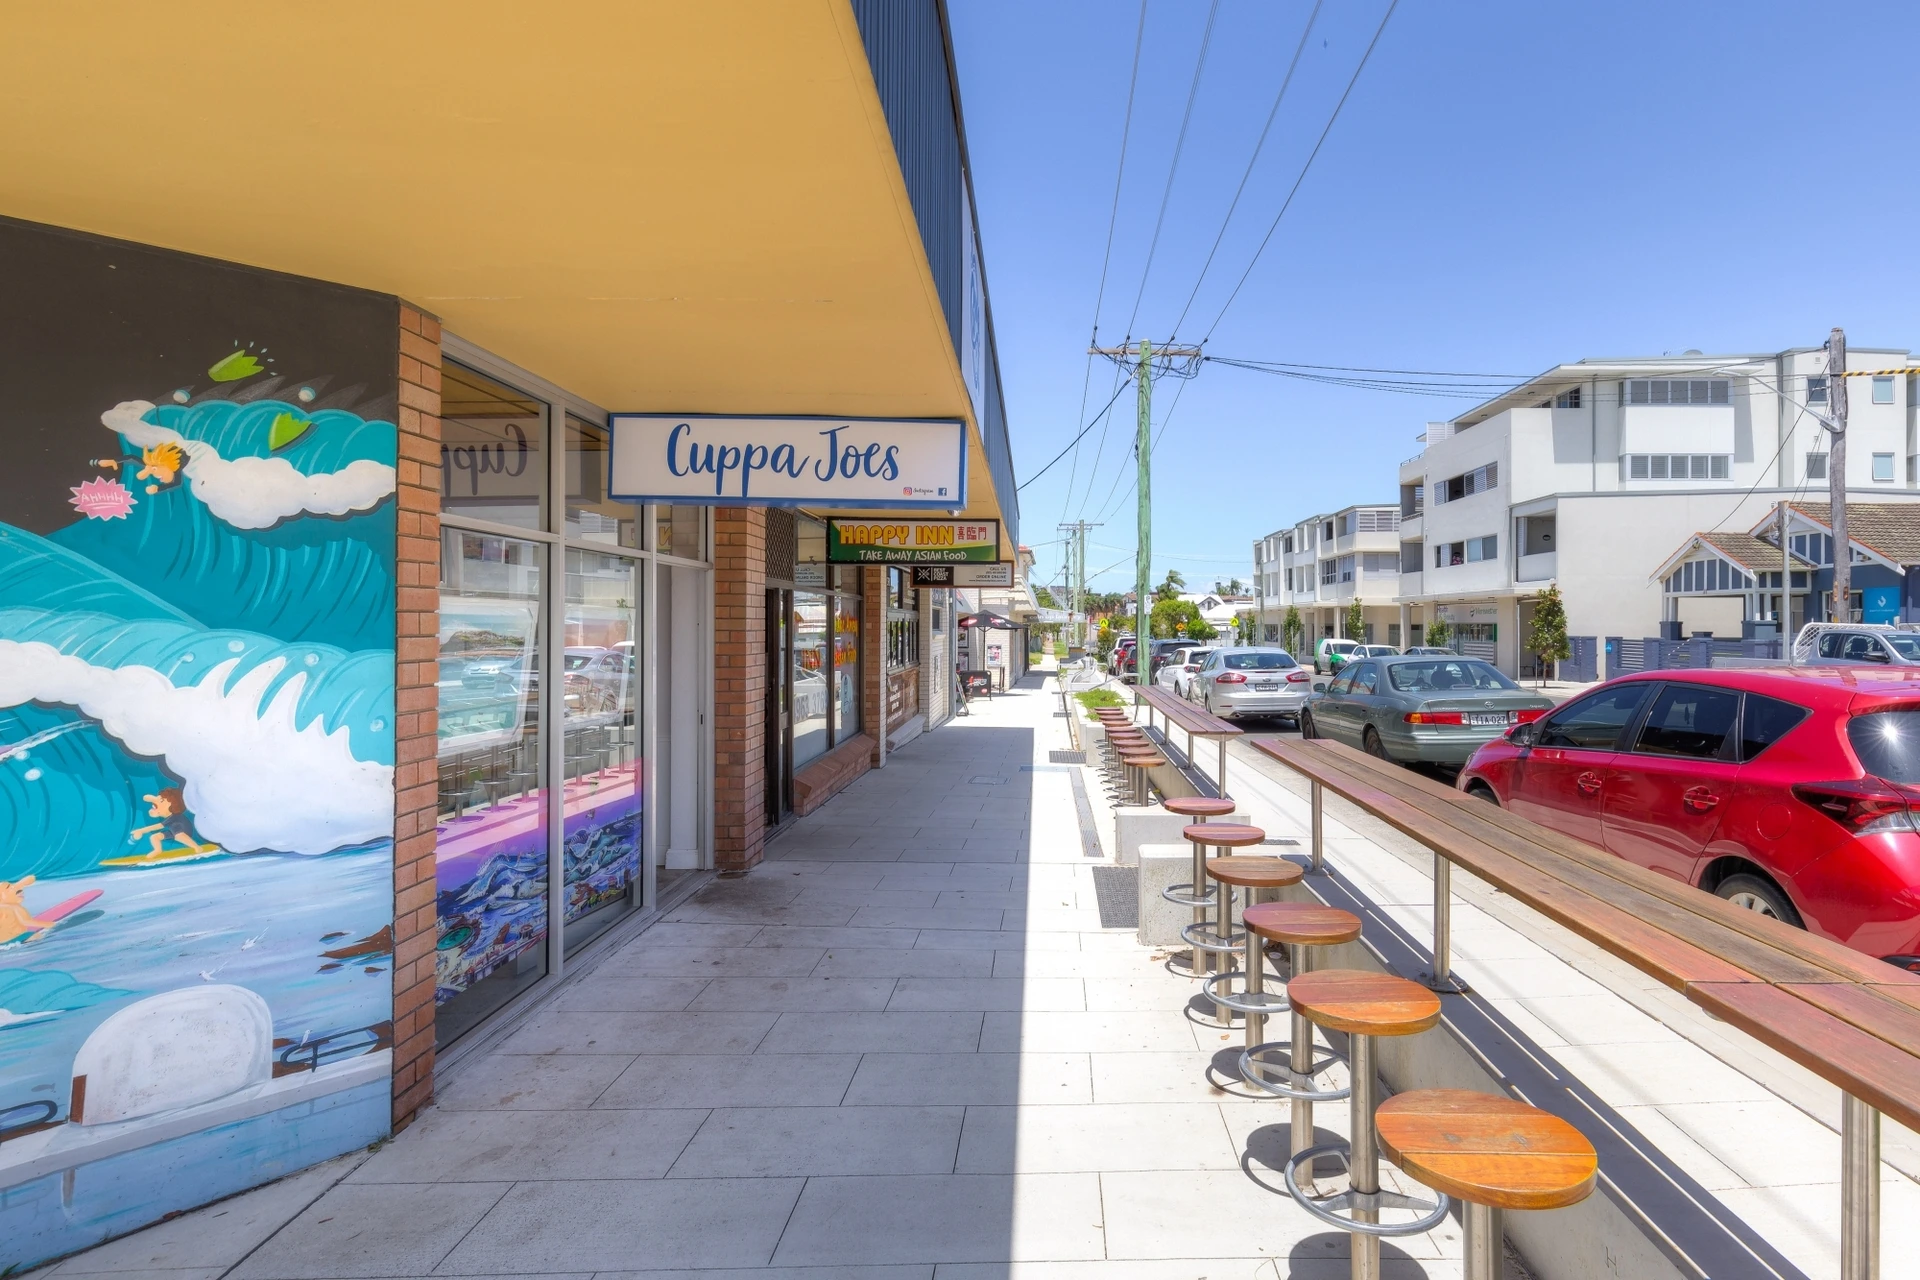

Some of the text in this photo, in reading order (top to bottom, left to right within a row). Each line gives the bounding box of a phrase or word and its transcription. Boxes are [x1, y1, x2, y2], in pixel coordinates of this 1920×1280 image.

[666, 423, 900, 498] Cuppa Joes
[81, 491, 123, 504] AHHHH
[840, 525, 955, 546] HAPPY INN
[859, 550, 883, 562] TAKE
[885, 550, 912, 561] AWAY
[914, 550, 942, 561] ASIAN
